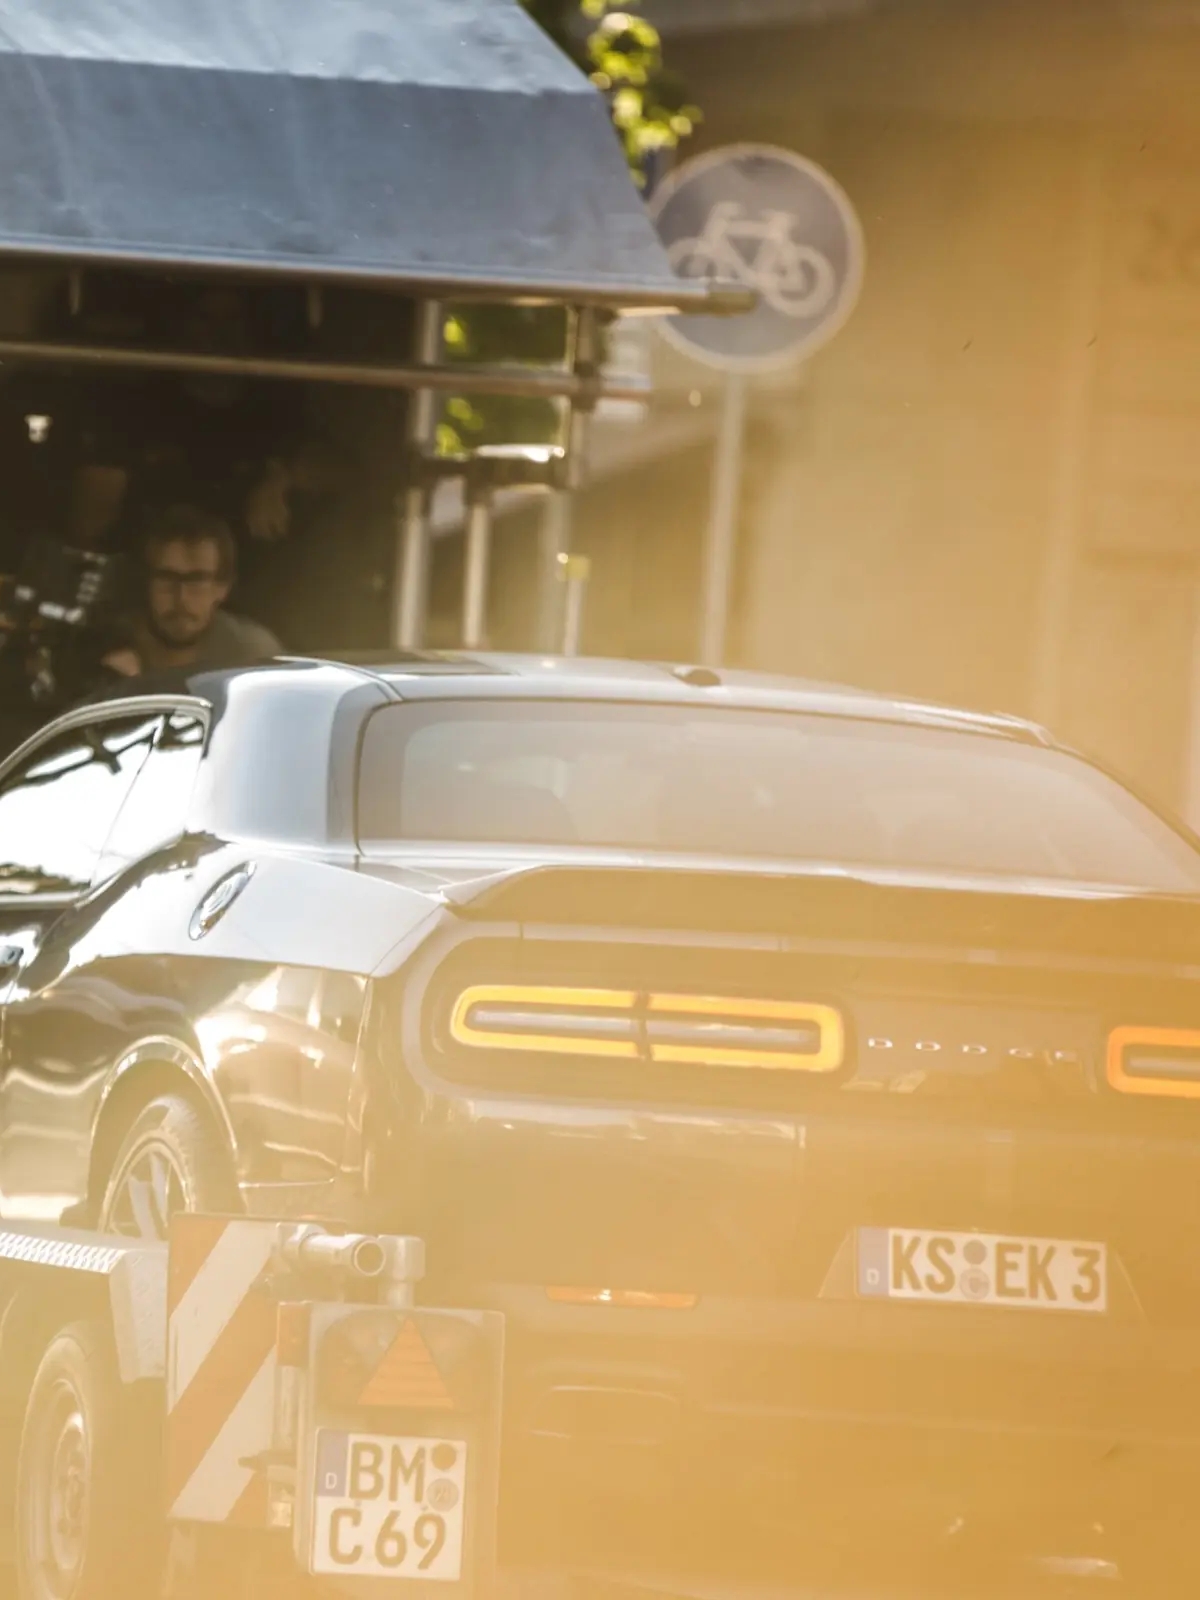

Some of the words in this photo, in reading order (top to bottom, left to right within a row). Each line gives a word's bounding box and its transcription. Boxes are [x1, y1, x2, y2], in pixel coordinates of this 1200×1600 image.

[892, 1234, 956, 1294] KS
[995, 1241, 1057, 1301] EK
[1071, 1247, 1101, 1304] 3
[325, 1472, 337, 1489] D
[349, 1441, 426, 1503] BM
[329, 1507, 364, 1565] C
[374, 1509, 446, 1571] 69
